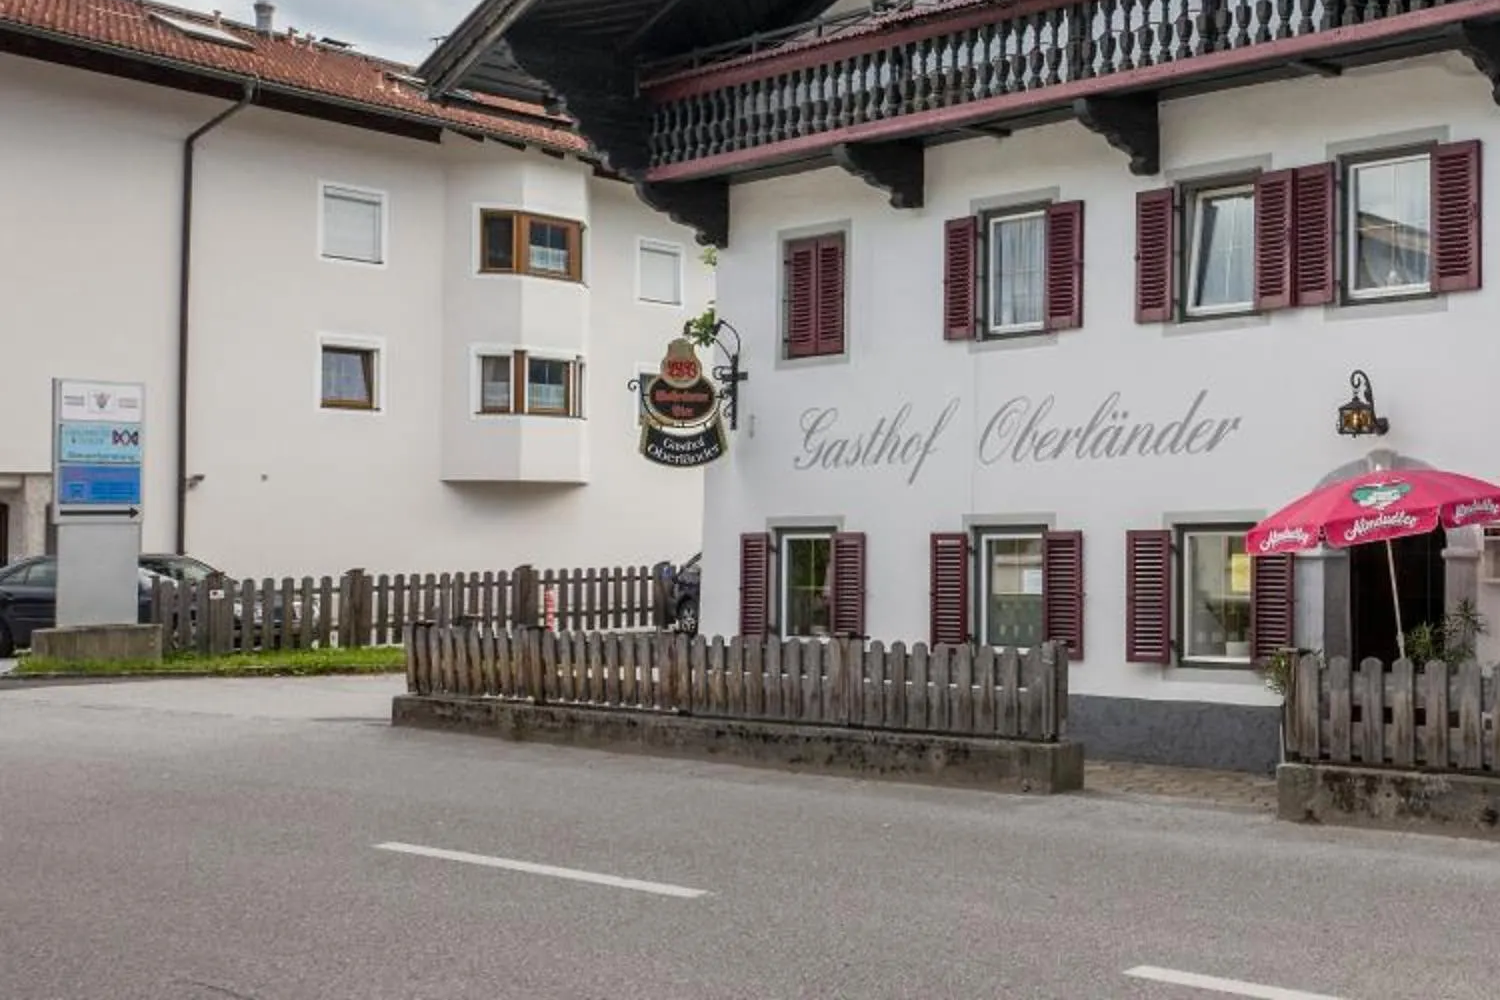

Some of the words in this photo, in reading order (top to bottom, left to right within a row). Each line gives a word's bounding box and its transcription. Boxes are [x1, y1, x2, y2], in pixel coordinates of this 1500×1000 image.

[793, 397, 961, 486] Gasthof
[977, 389, 1242, 466] Oberländer
[1343, 510, 1418, 541] Almdudler
